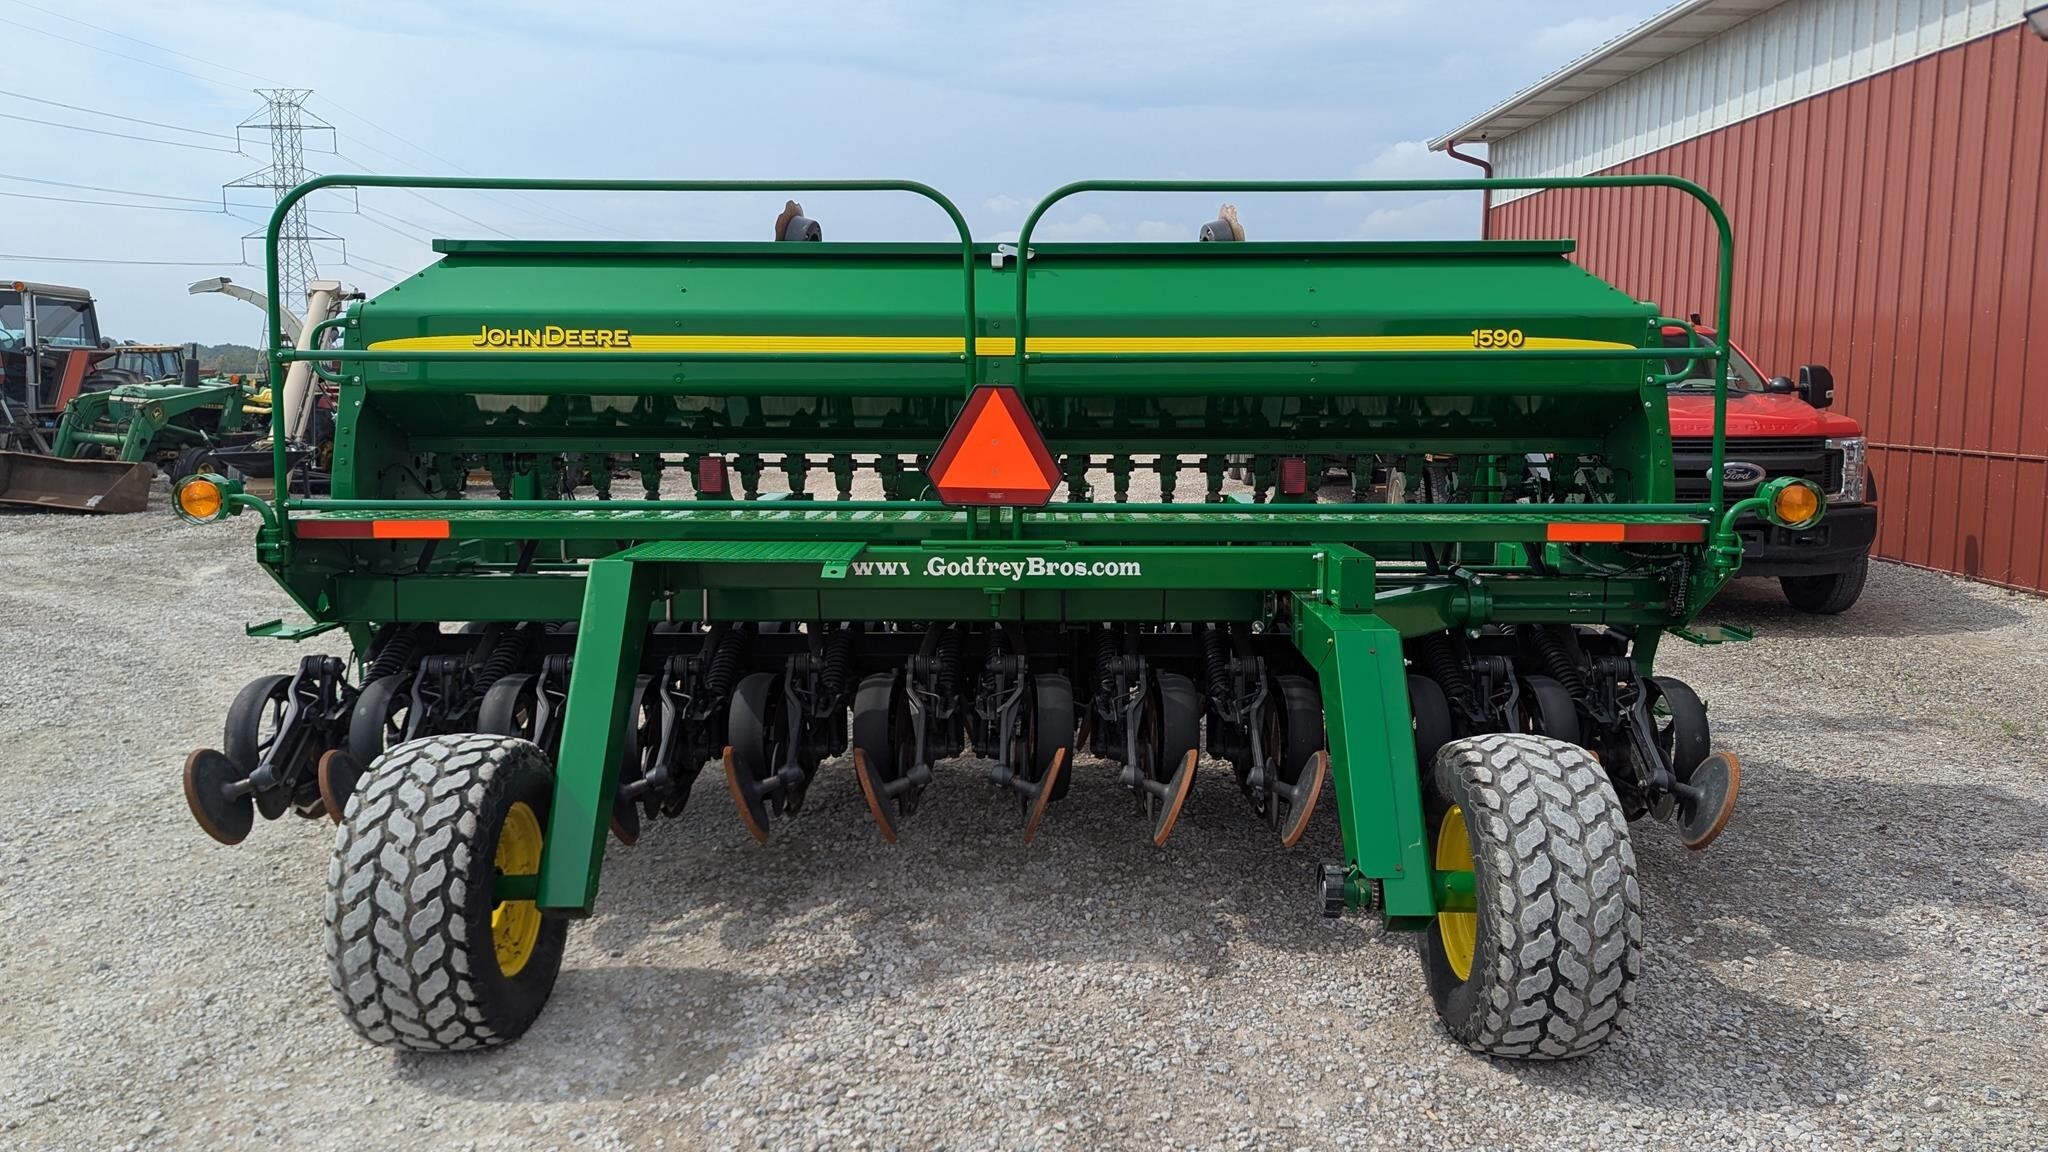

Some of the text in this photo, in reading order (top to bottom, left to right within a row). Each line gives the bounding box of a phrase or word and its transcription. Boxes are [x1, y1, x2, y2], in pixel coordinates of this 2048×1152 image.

[473, 325, 630, 347] JOHN DEERE
[1471, 328, 1524, 347] 1590
[1723, 468, 1751, 480] Ford
